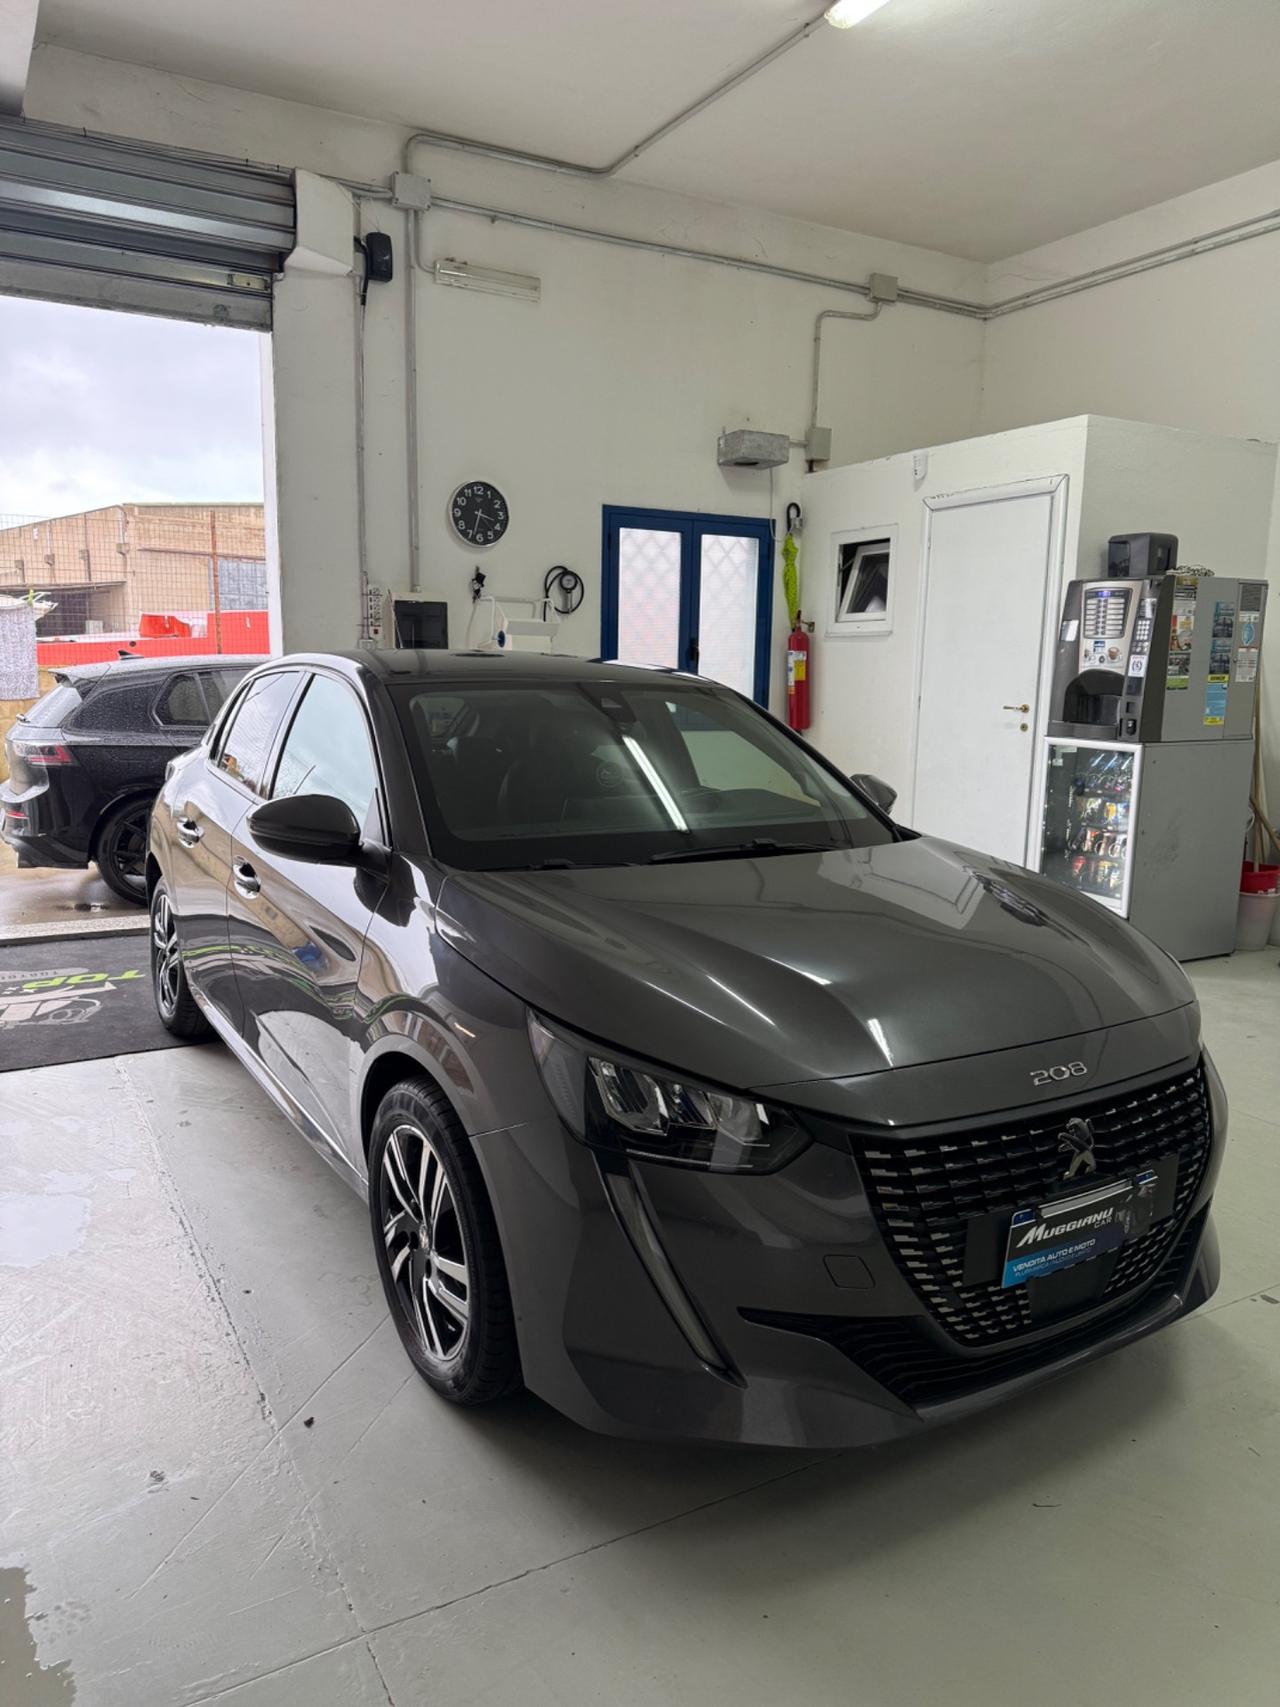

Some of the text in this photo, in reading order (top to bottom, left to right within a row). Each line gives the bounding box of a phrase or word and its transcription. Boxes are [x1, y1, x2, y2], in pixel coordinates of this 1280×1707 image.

[464, 488, 472, 498] 11
[473, 486, 484, 495] 12
[487, 490, 492, 499] 1
[457, 496, 467, 506] 10
[494, 500, 501, 509] 2
[454, 508, 461, 517] 9
[498, 511, 505, 520] 3
[458, 520, 465, 529] 8
[494, 523, 501, 531] 4
[467, 529, 474, 539] 7
[476, 533, 484, 543] 6
[487, 530, 494, 540] 5
[1030, 1061, 1087, 1086] 208
[1016, 1208, 1114, 1248] MUGGIANU
[1012, 1256, 1046, 1272] VENDITA
[1047, 1248, 1069, 1262] AUTO
[1074, 1238, 1096, 1252] MOTO
